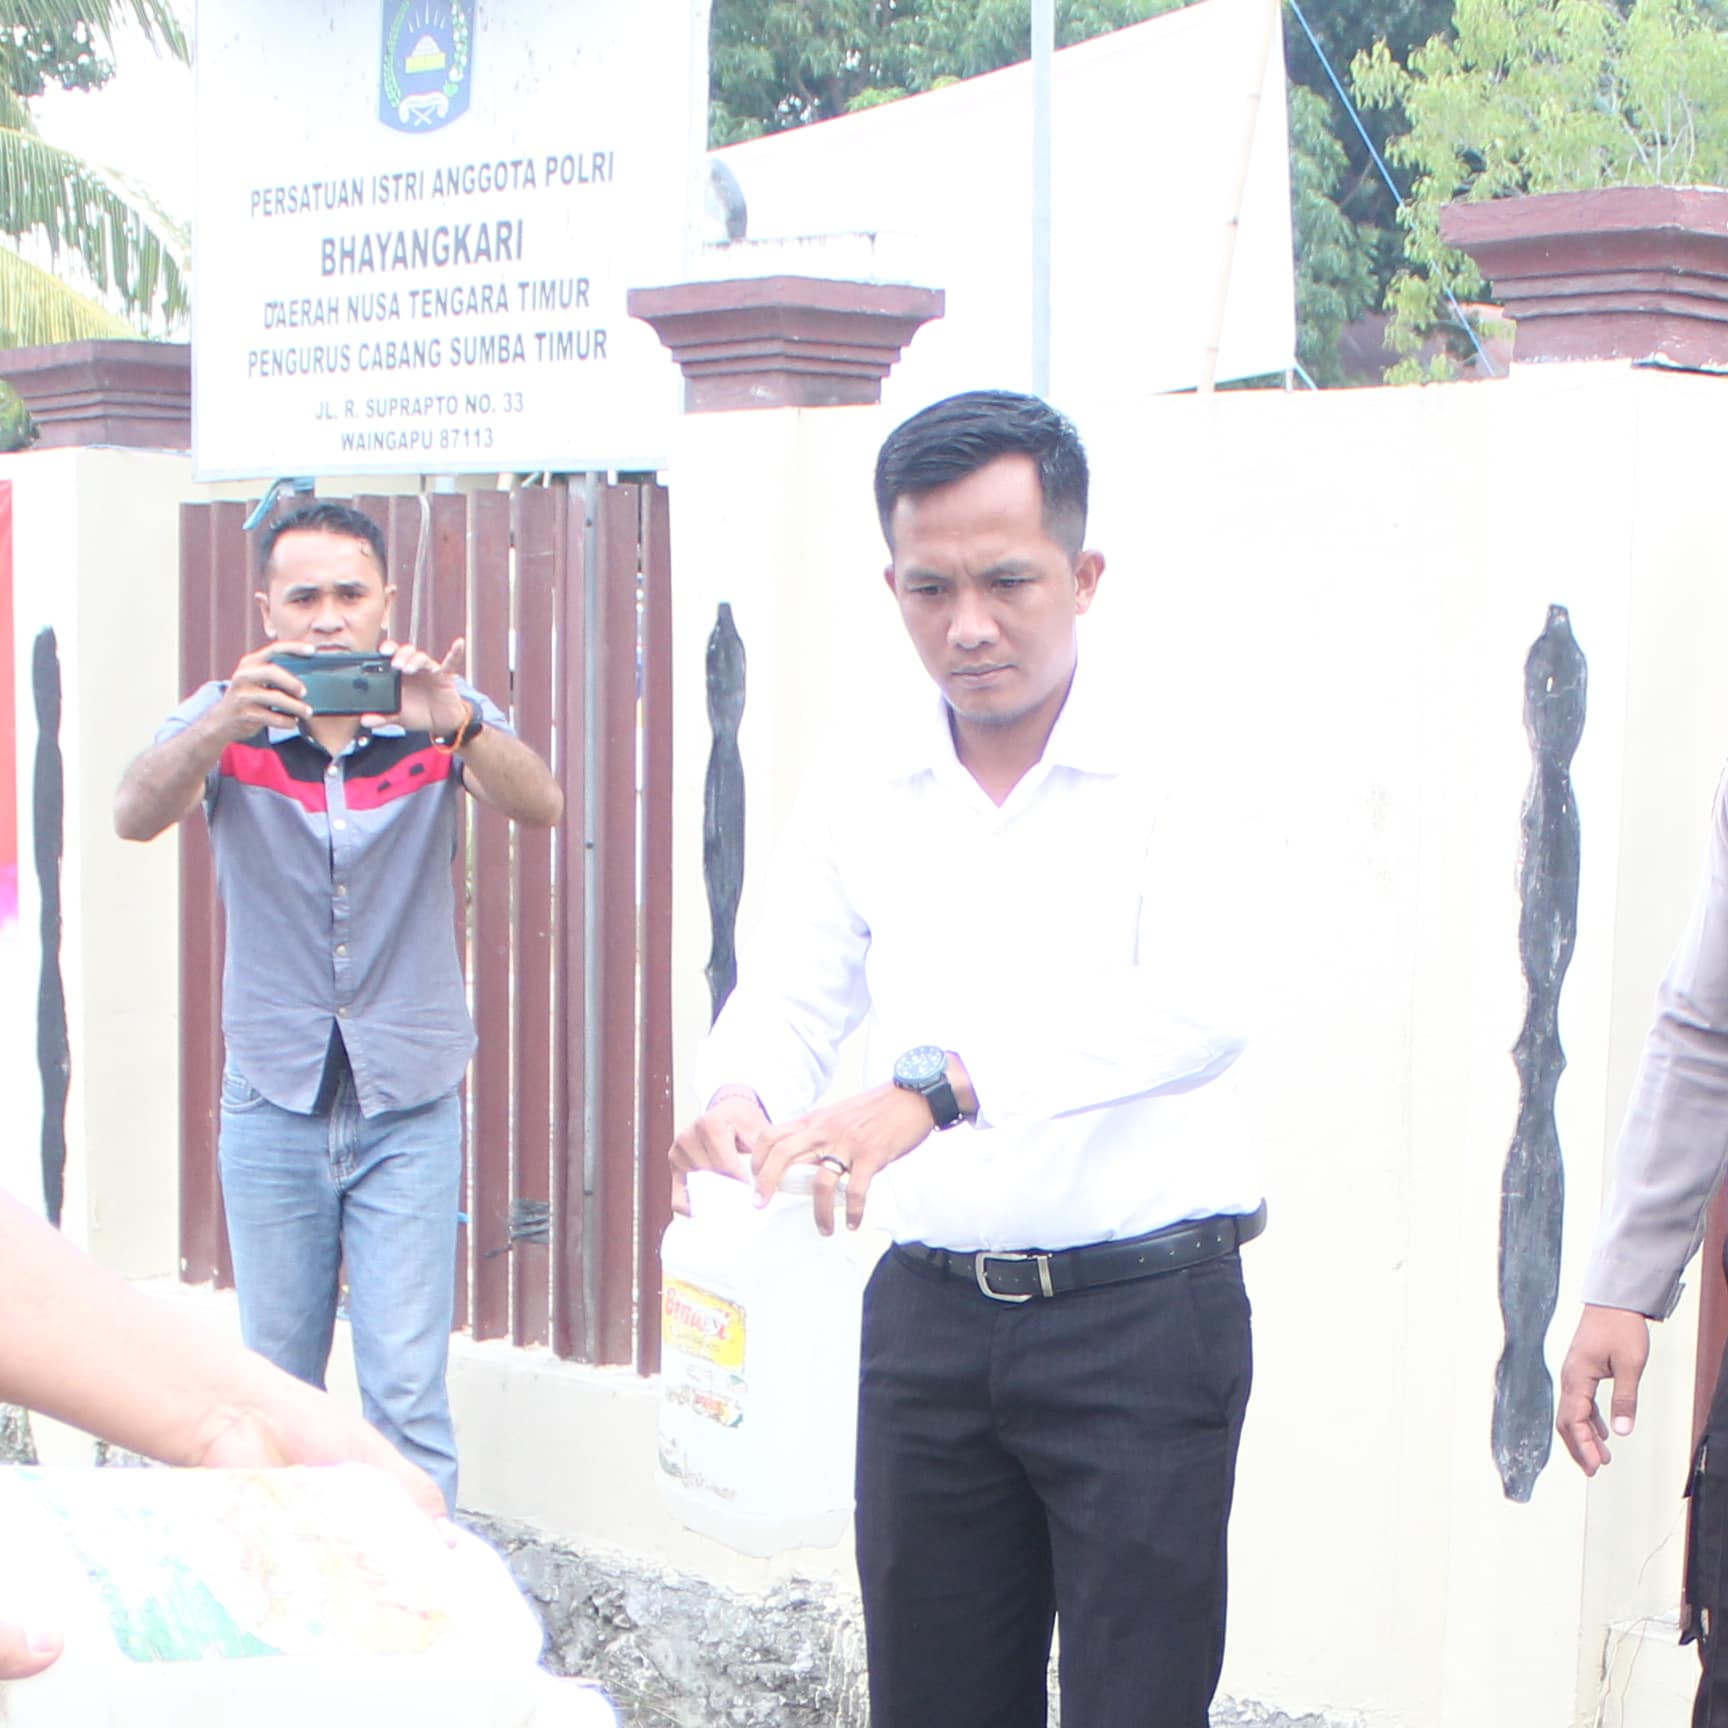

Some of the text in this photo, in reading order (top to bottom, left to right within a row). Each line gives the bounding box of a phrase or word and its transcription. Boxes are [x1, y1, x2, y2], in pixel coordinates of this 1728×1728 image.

[251, 151, 614, 218] PERSATUAN ISTRI ANGGOTA POLRI
[321, 219, 524, 277] BHAYANGKARI
[263, 278, 590, 330] DAERAH NUSA TENGARA TIMUR
[248, 329, 608, 378] PENGURUS CABANG SUMBA TIMUR
[315, 392, 524, 421] JL. R. SUPRAPTO NO. 33
[341, 429, 494, 453] WAINGAPU 87113
